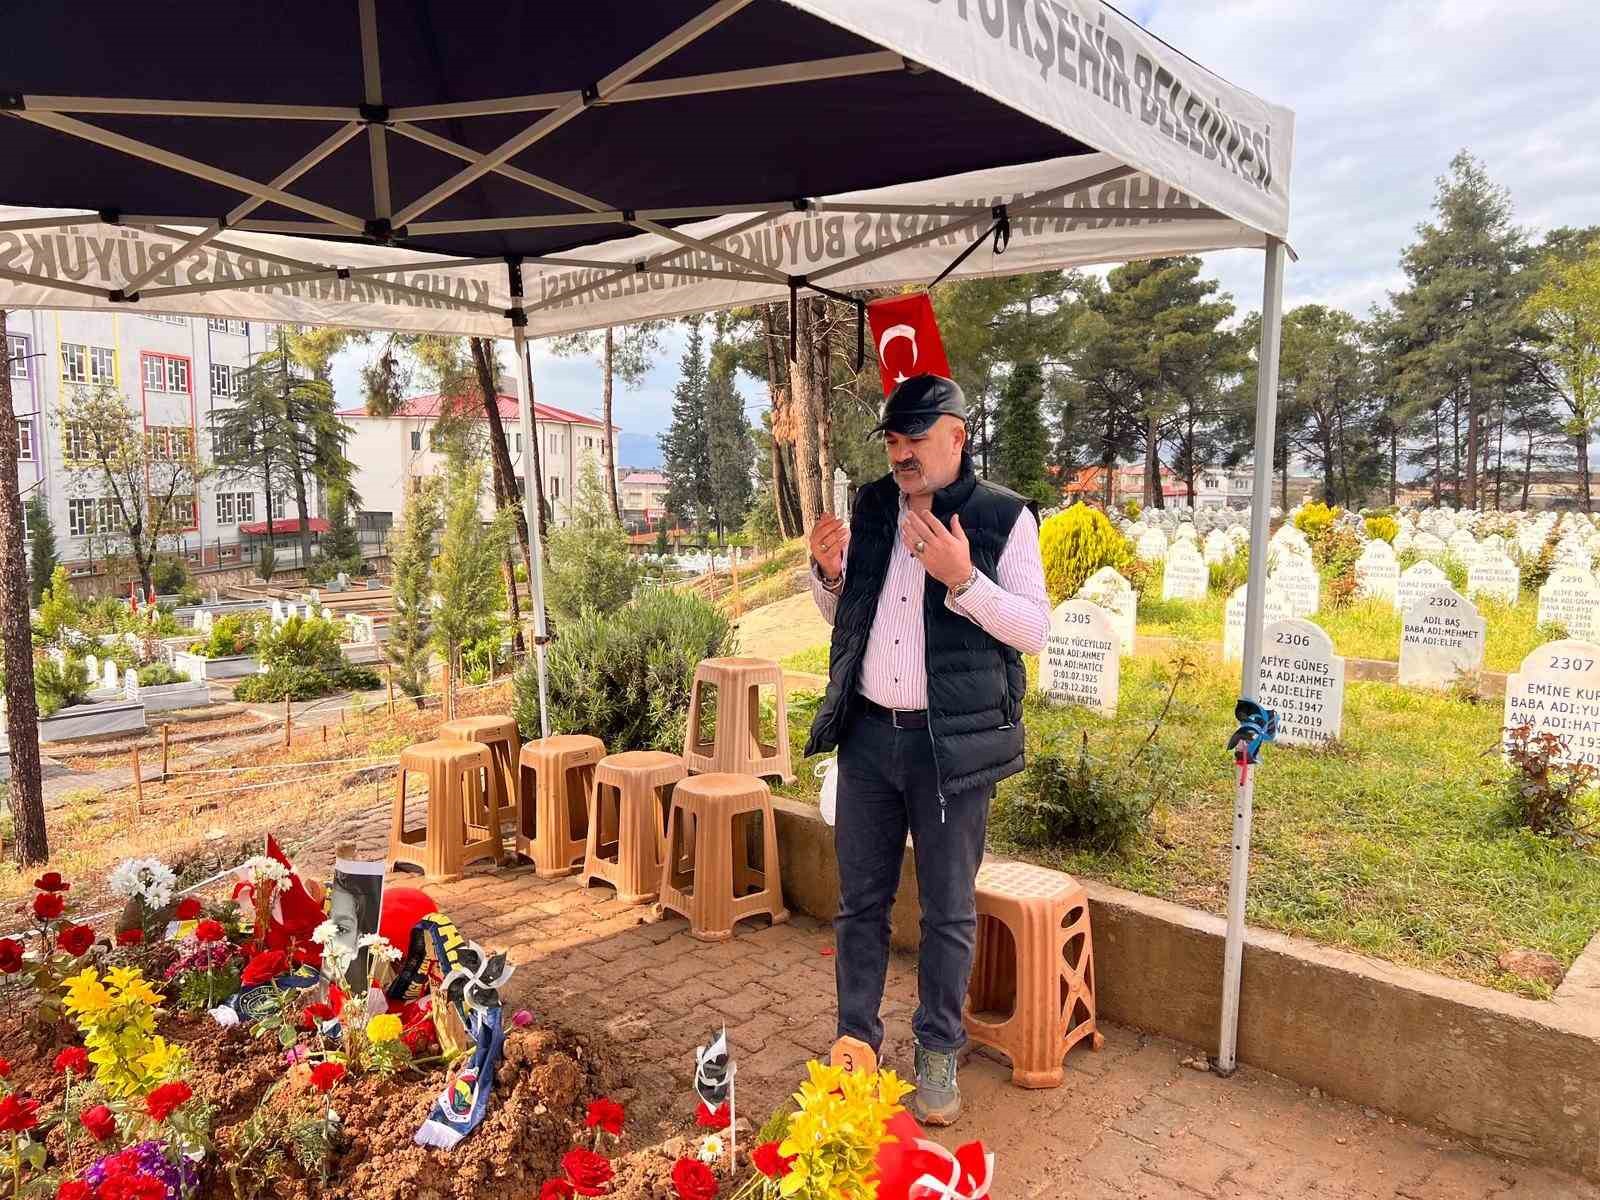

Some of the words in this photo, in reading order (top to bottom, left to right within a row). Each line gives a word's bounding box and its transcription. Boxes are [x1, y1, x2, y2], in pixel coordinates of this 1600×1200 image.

[1134, 53, 1273, 194] BELEDİYESİ
[1429, 596, 1458, 608] 2302
[1064, 612, 1092, 624] 2305
[1444, 617, 1461, 629] BAŞ
[1276, 632, 1310, 647] 2306
[1404, 624, 1425, 634] BABA
[1426, 626, 1479, 640] ADI:MEHMET
[1404, 635, 1420, 645] ANA
[1048, 646, 1065, 657] BABA
[1066, 649, 1106, 662] ADI:AHMET
[1048, 657, 1062, 668] ANA
[1293, 658, 1329, 676] GÜNEŞ
[1549, 656, 1595, 672] 2307
[1276, 671, 1336, 689] ADI:AHMET
[1270, 684, 1323, 701] ADI:ELİFE
[1527, 682, 1571, 699] EMİNE
[1511, 696, 1545, 711] BABA
